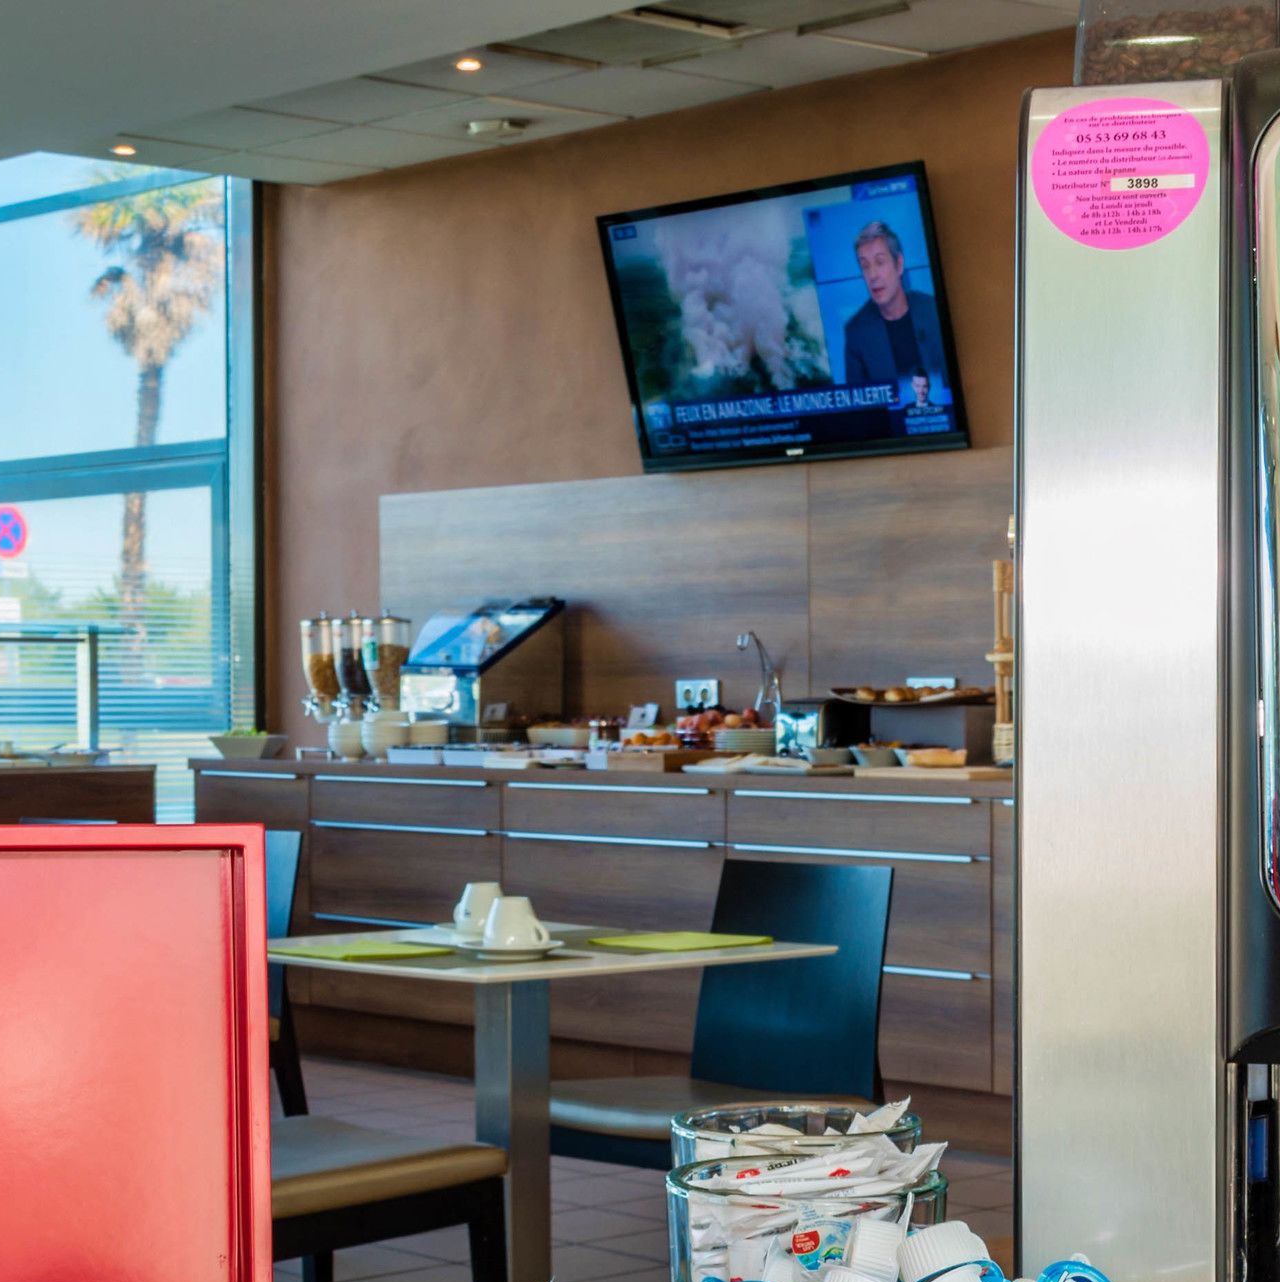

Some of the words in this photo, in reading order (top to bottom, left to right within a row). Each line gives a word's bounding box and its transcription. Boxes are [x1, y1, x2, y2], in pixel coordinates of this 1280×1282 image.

[1076, 134, 1092, 143] 05
[1095, 133, 1110, 142] 53
[1113, 132, 1129, 141] 69
[1133, 131, 1148, 140] 68
[1151, 130, 1166, 140] 43
[1111, 155, 1156, 163] distributeur
[1127, 178, 1159, 189] 3898
[702, 402, 718, 422] EN
[834, 390, 852, 408] EN
